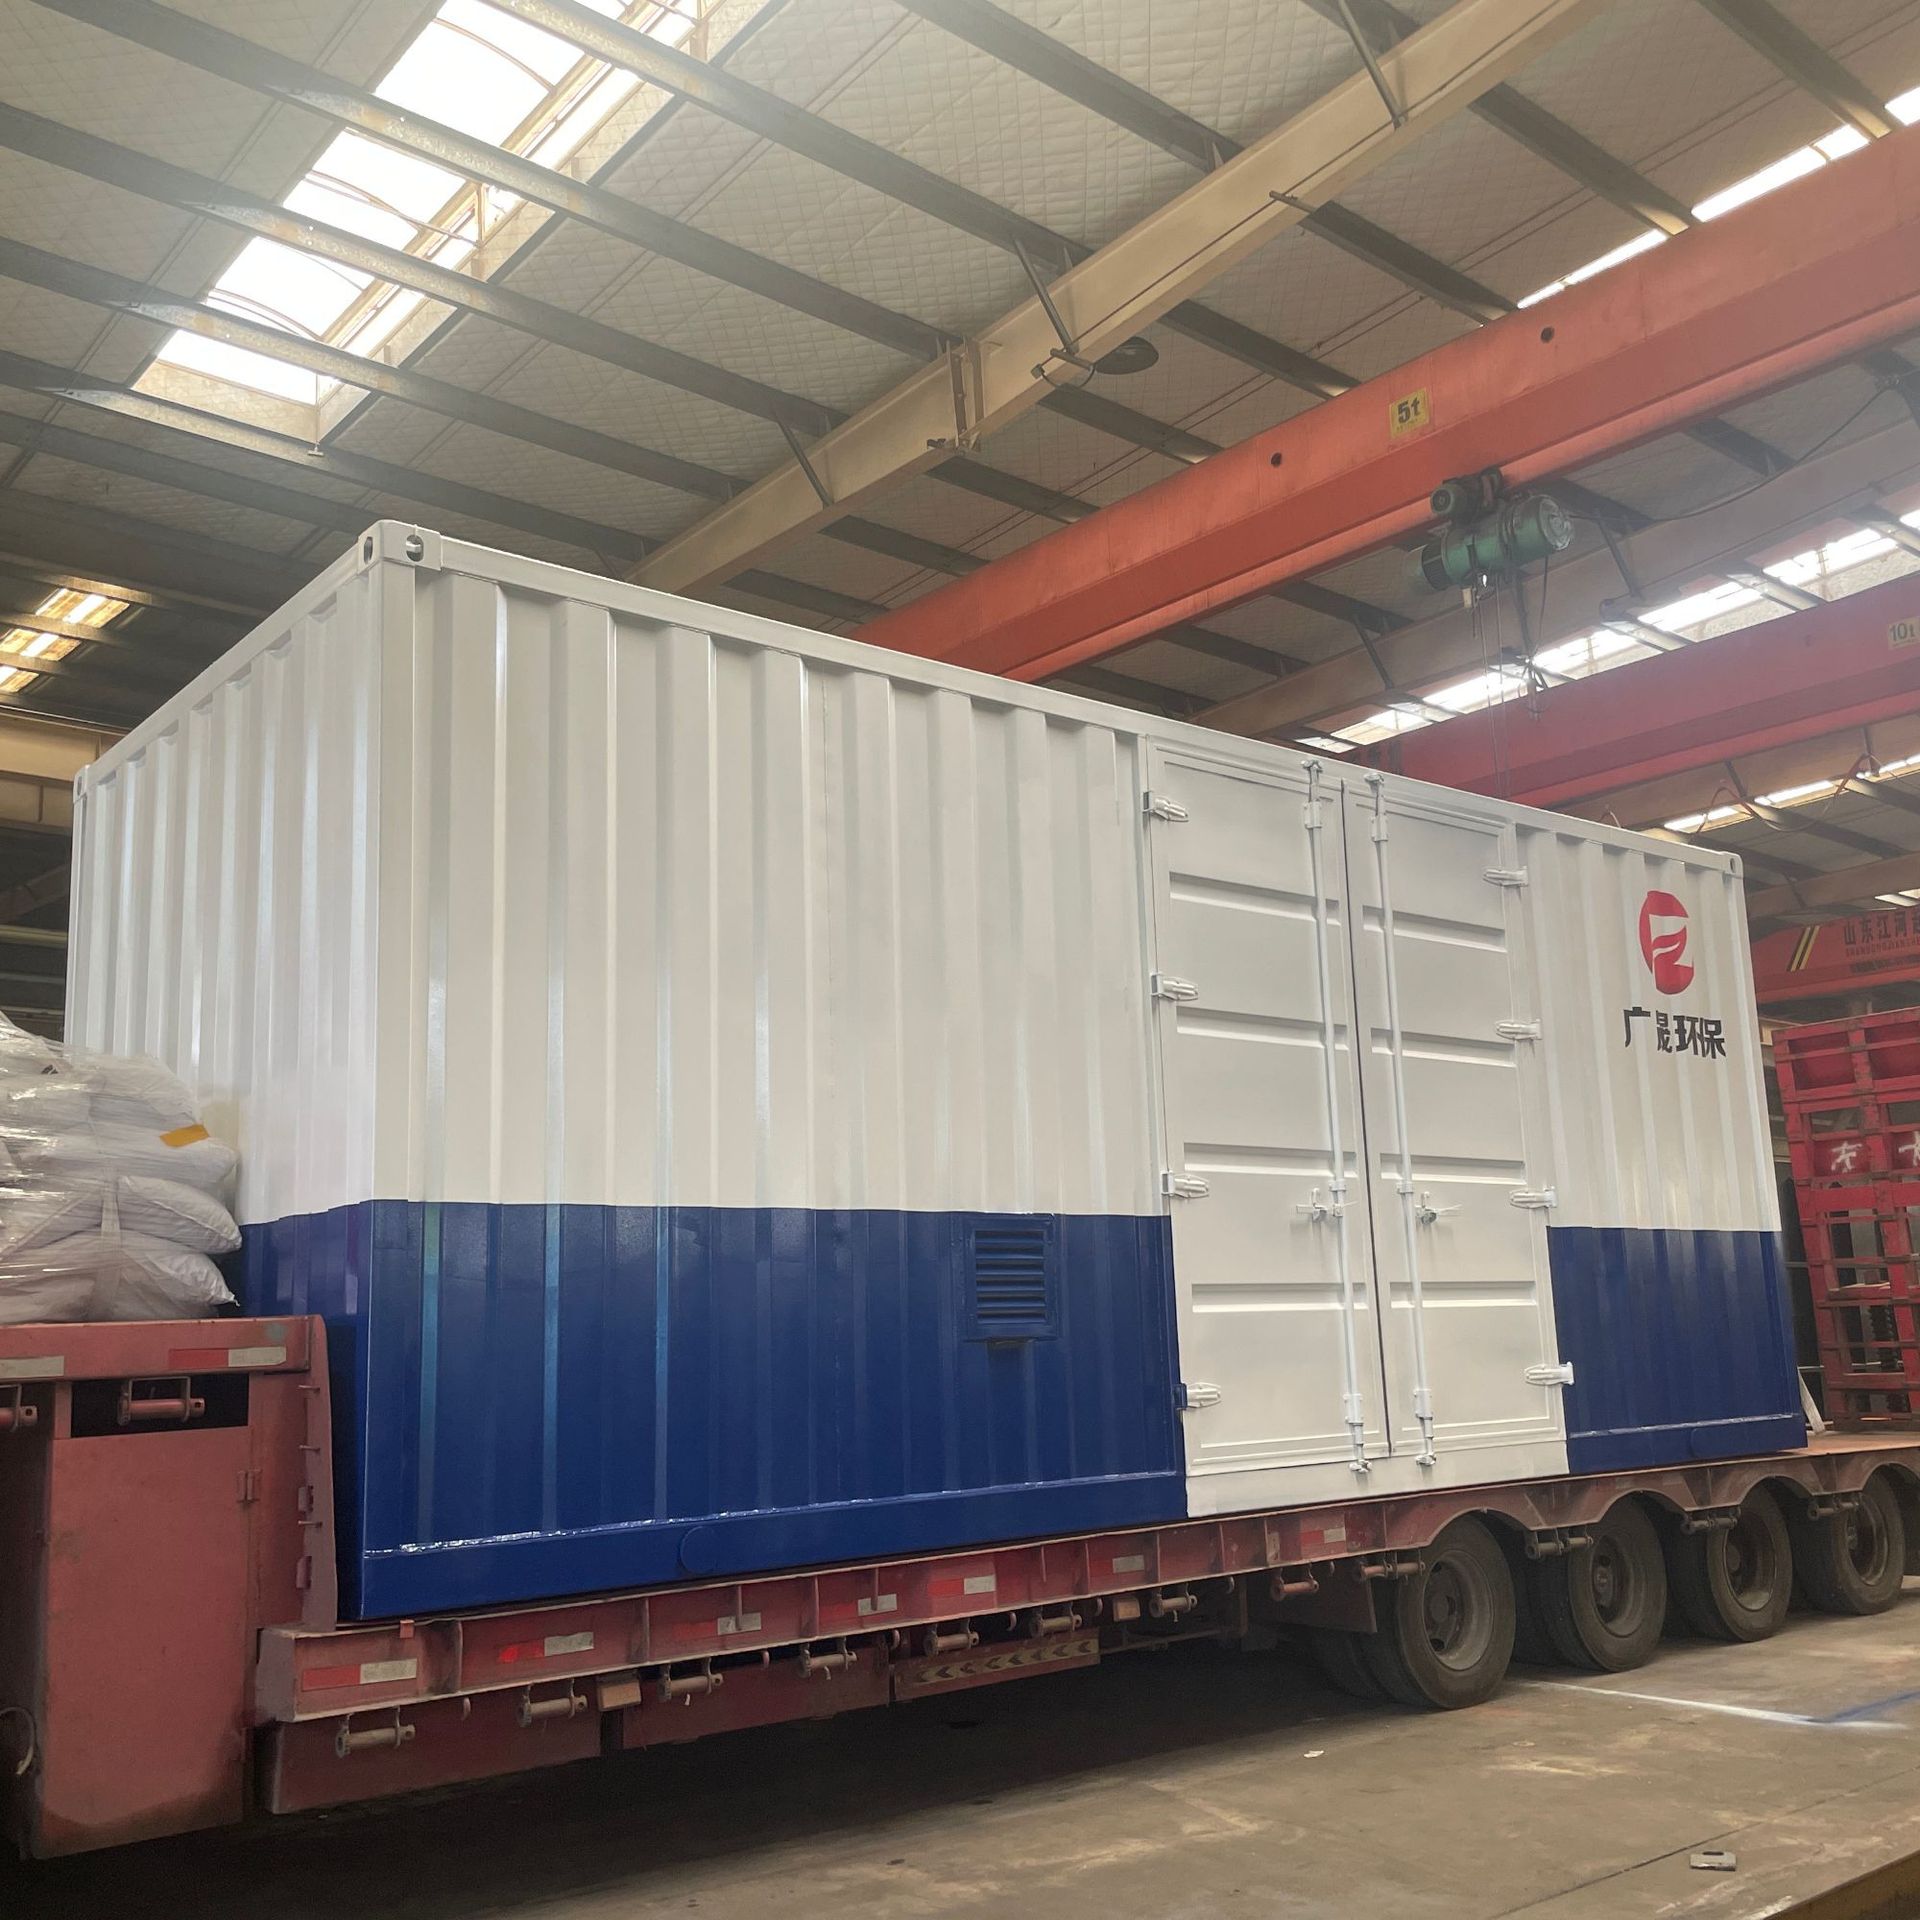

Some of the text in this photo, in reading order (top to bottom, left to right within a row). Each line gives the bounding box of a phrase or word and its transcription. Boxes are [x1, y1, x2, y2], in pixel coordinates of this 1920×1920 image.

[1397, 397, 1420, 424] 5t
[1624, 1006, 1727, 1059] 广晟环保
